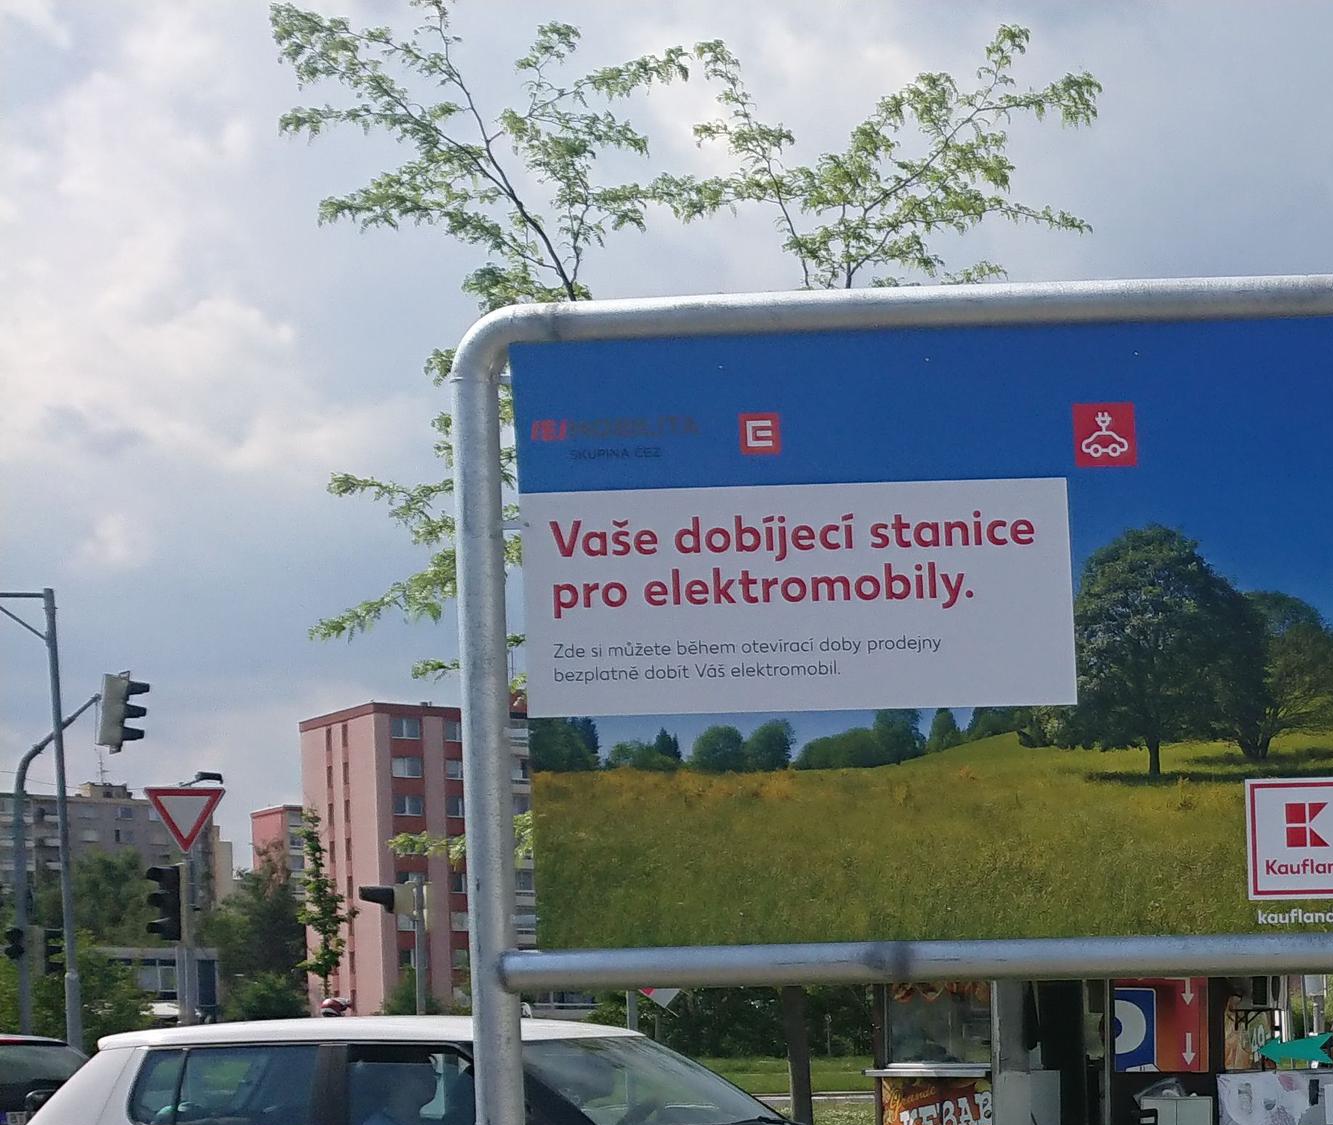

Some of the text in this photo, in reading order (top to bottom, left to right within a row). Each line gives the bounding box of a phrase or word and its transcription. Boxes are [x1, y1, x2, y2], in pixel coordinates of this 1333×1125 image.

[549, 510, 1035, 561] Vaše dobíjecí stanice
[553, 561, 974, 619] pro elektromobily.
[553, 635, 942, 659] Zde si můžete během otevírací doby prodejny
[553, 661, 841, 685] bezplatně dobít Váš elektromobil.
